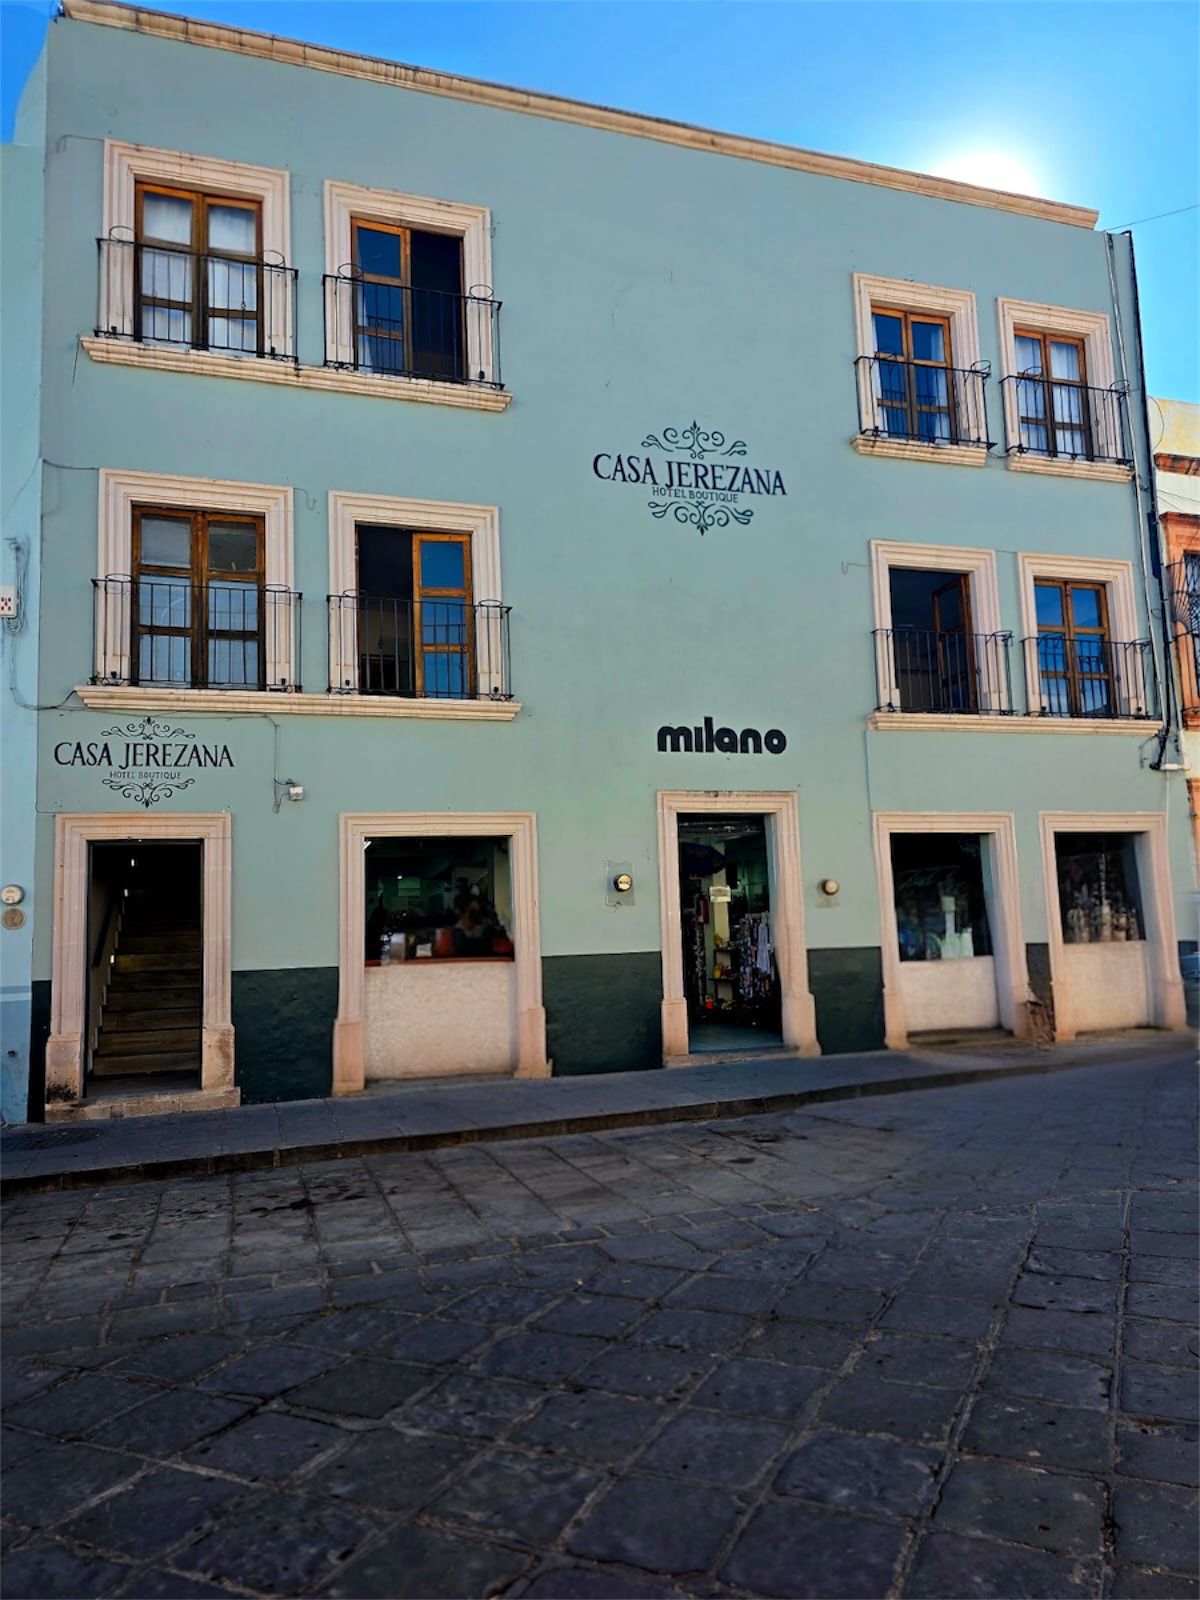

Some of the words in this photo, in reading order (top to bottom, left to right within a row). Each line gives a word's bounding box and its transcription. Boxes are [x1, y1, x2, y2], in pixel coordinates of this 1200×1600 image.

[593, 453, 658, 486] CASA
[665, 460, 788, 496] JEREZANA
[652, 486, 687, 499] HOTEL
[689, 489, 739, 503] BOUTIQUE
[657, 716, 788, 755] milano
[54, 741, 112, 767] CASA
[118, 742, 235, 770] JEREZANA
[110, 771, 135, 779] HOTEL
[138, 771, 182, 779] BOUTIQUE
